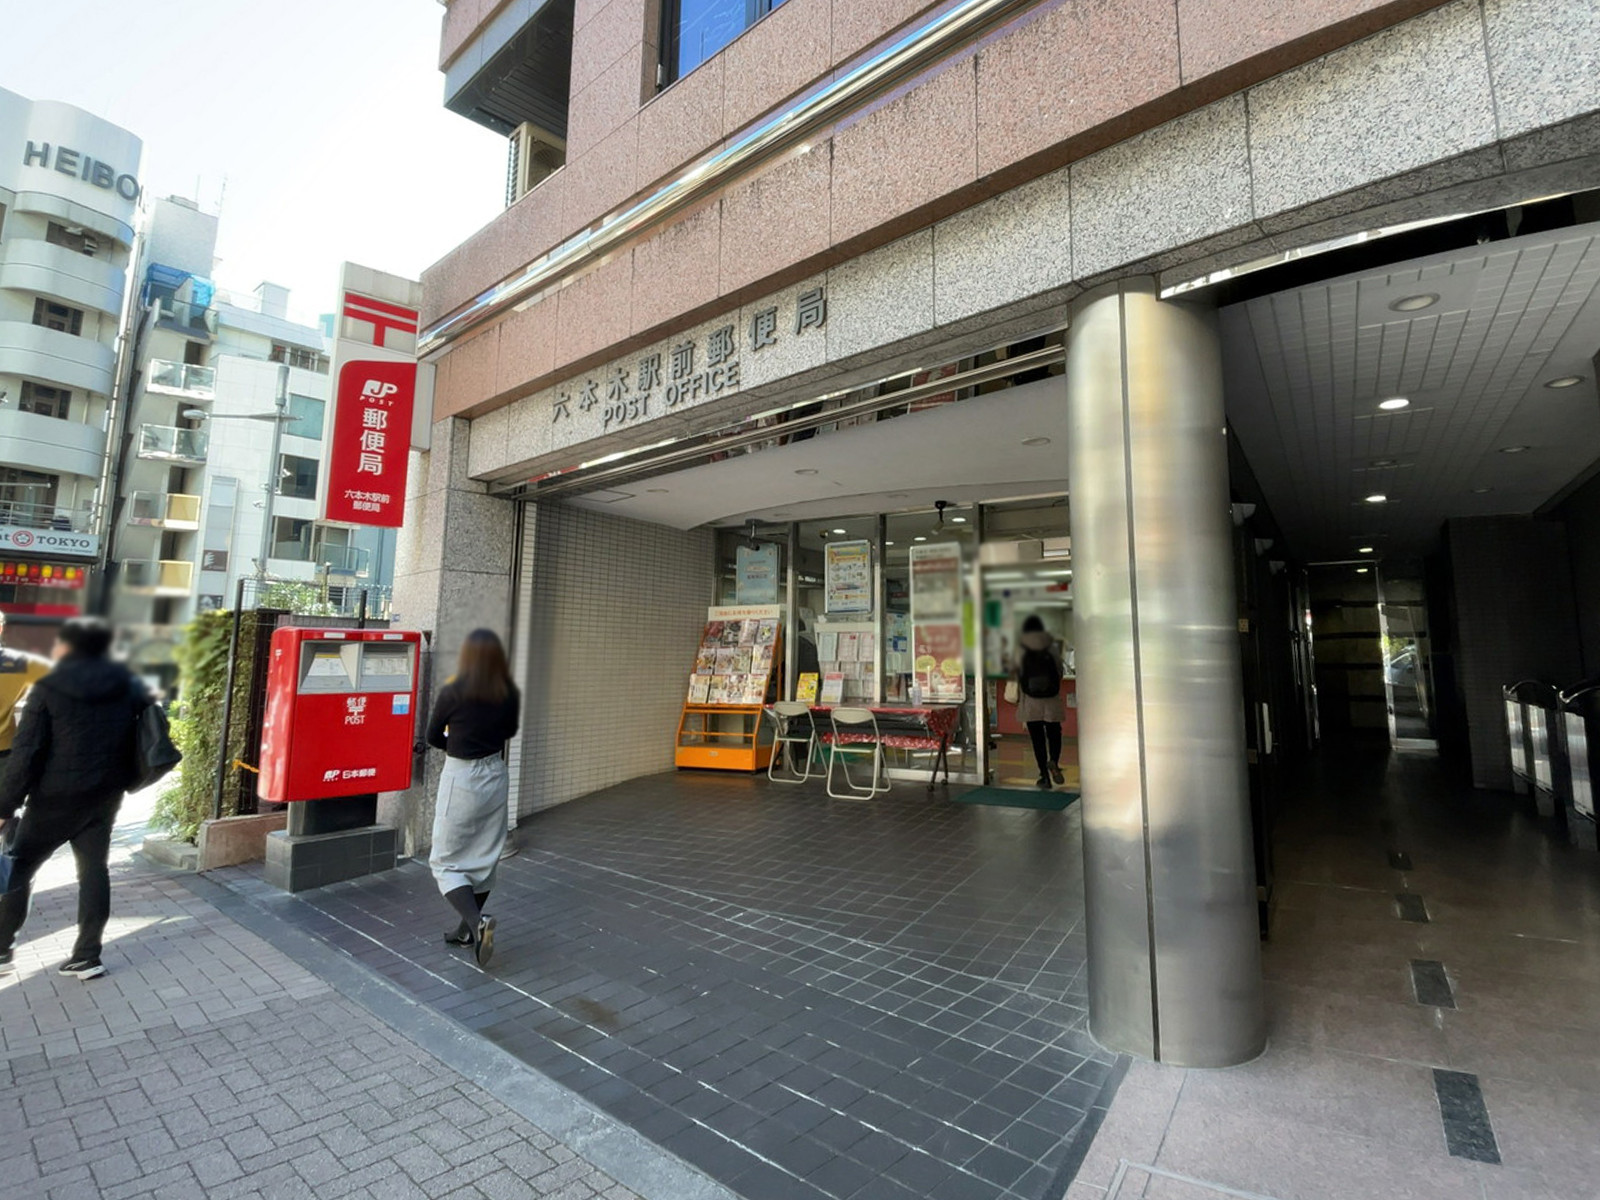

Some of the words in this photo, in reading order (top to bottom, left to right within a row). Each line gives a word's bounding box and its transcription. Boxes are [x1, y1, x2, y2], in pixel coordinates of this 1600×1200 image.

[552, 286, 828, 424] 六本木駅前郵便局
[359, 395, 394, 407] POST
[601, 394, 651, 430] POST
[665, 360, 740, 407] OFFICE
[356, 407, 388, 476] 郵便局
[344, 489, 391, 505] 六本木駅前
[352, 500, 381, 513] 郵便局
[36, 535, 91, 549] TOKYO
[344, 714, 366, 725] POST
